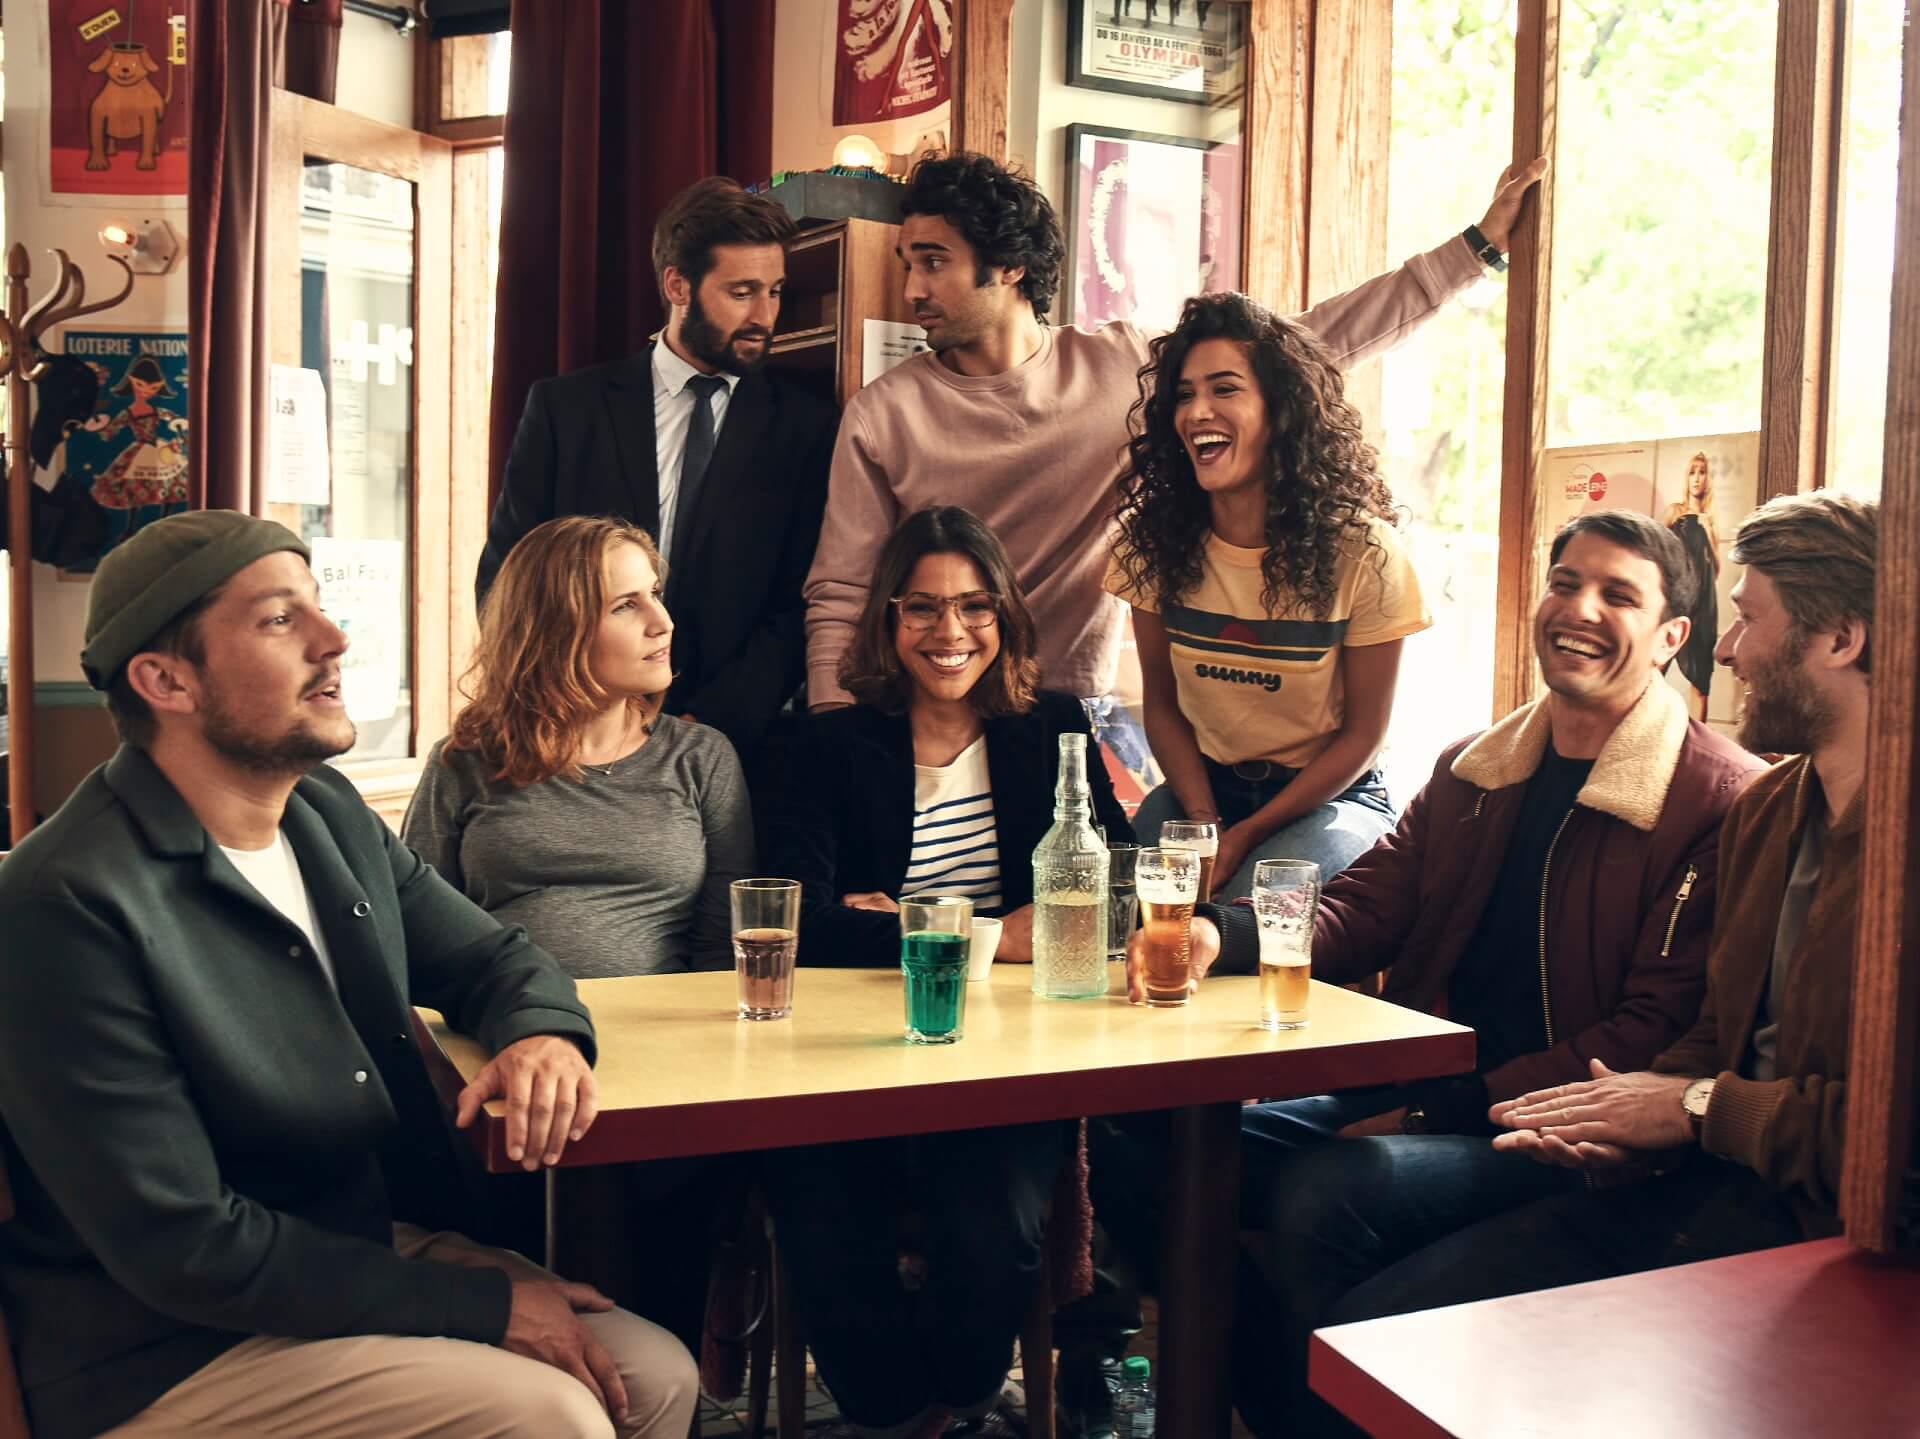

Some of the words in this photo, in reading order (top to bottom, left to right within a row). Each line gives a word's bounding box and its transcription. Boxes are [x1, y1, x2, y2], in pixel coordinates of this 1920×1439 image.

[1096, 29, 1108, 39] DU
[1119, 42, 1201, 68] OLYMPIA
[67, 338, 131, 354] LOTERIE
[323, 564, 350, 583] Bal
[1195, 663, 1282, 693] sunny
